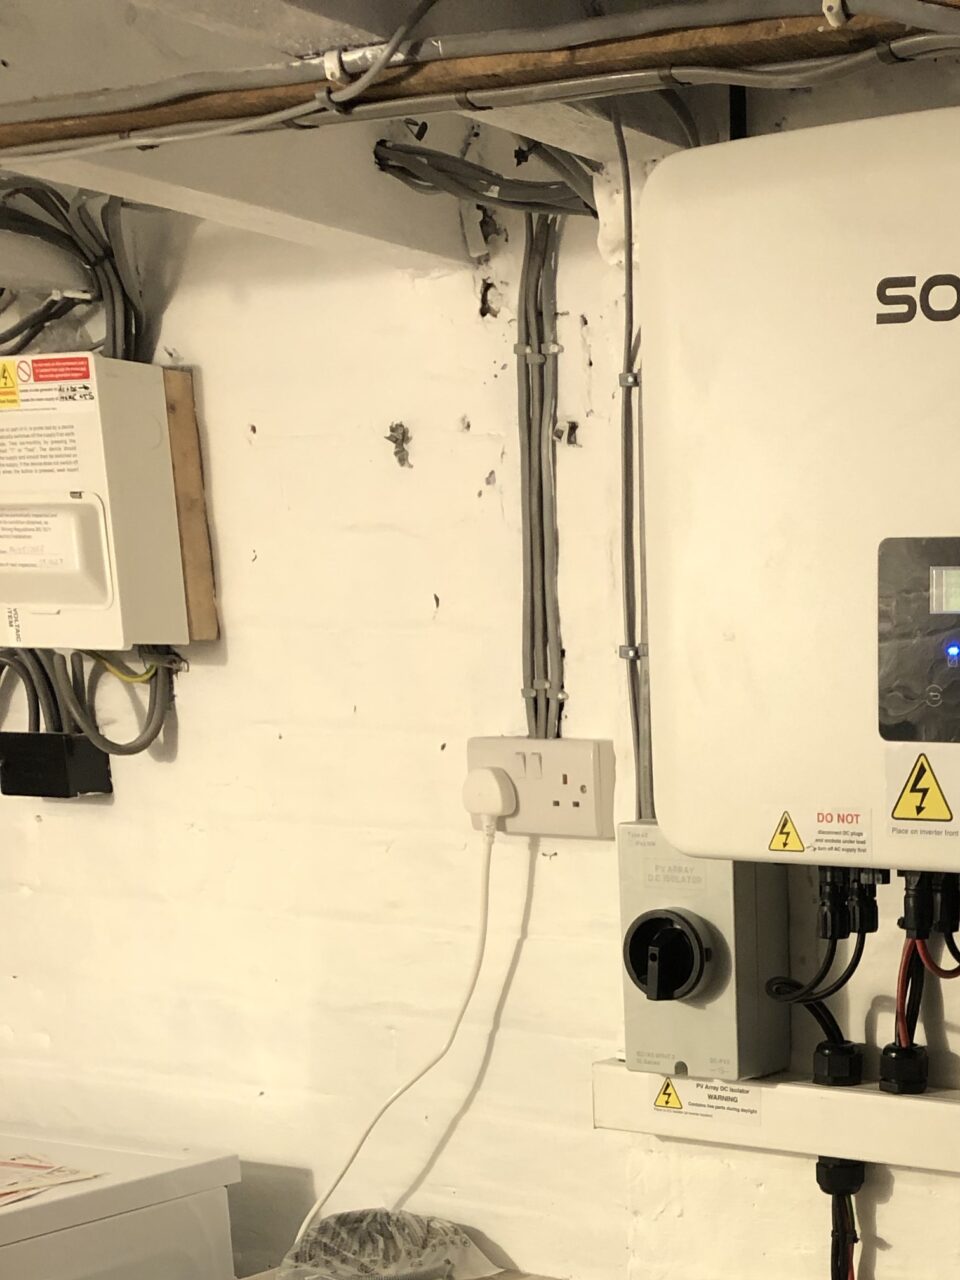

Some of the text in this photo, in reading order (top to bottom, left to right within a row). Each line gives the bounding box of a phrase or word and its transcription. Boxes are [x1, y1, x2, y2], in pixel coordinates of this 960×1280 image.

[816, 812, 861, 825] DO NOT
[892, 827, 909, 835] Place
[704, 1084, 719, 1092] Array
[707, 1094, 738, 1103] WARNING
